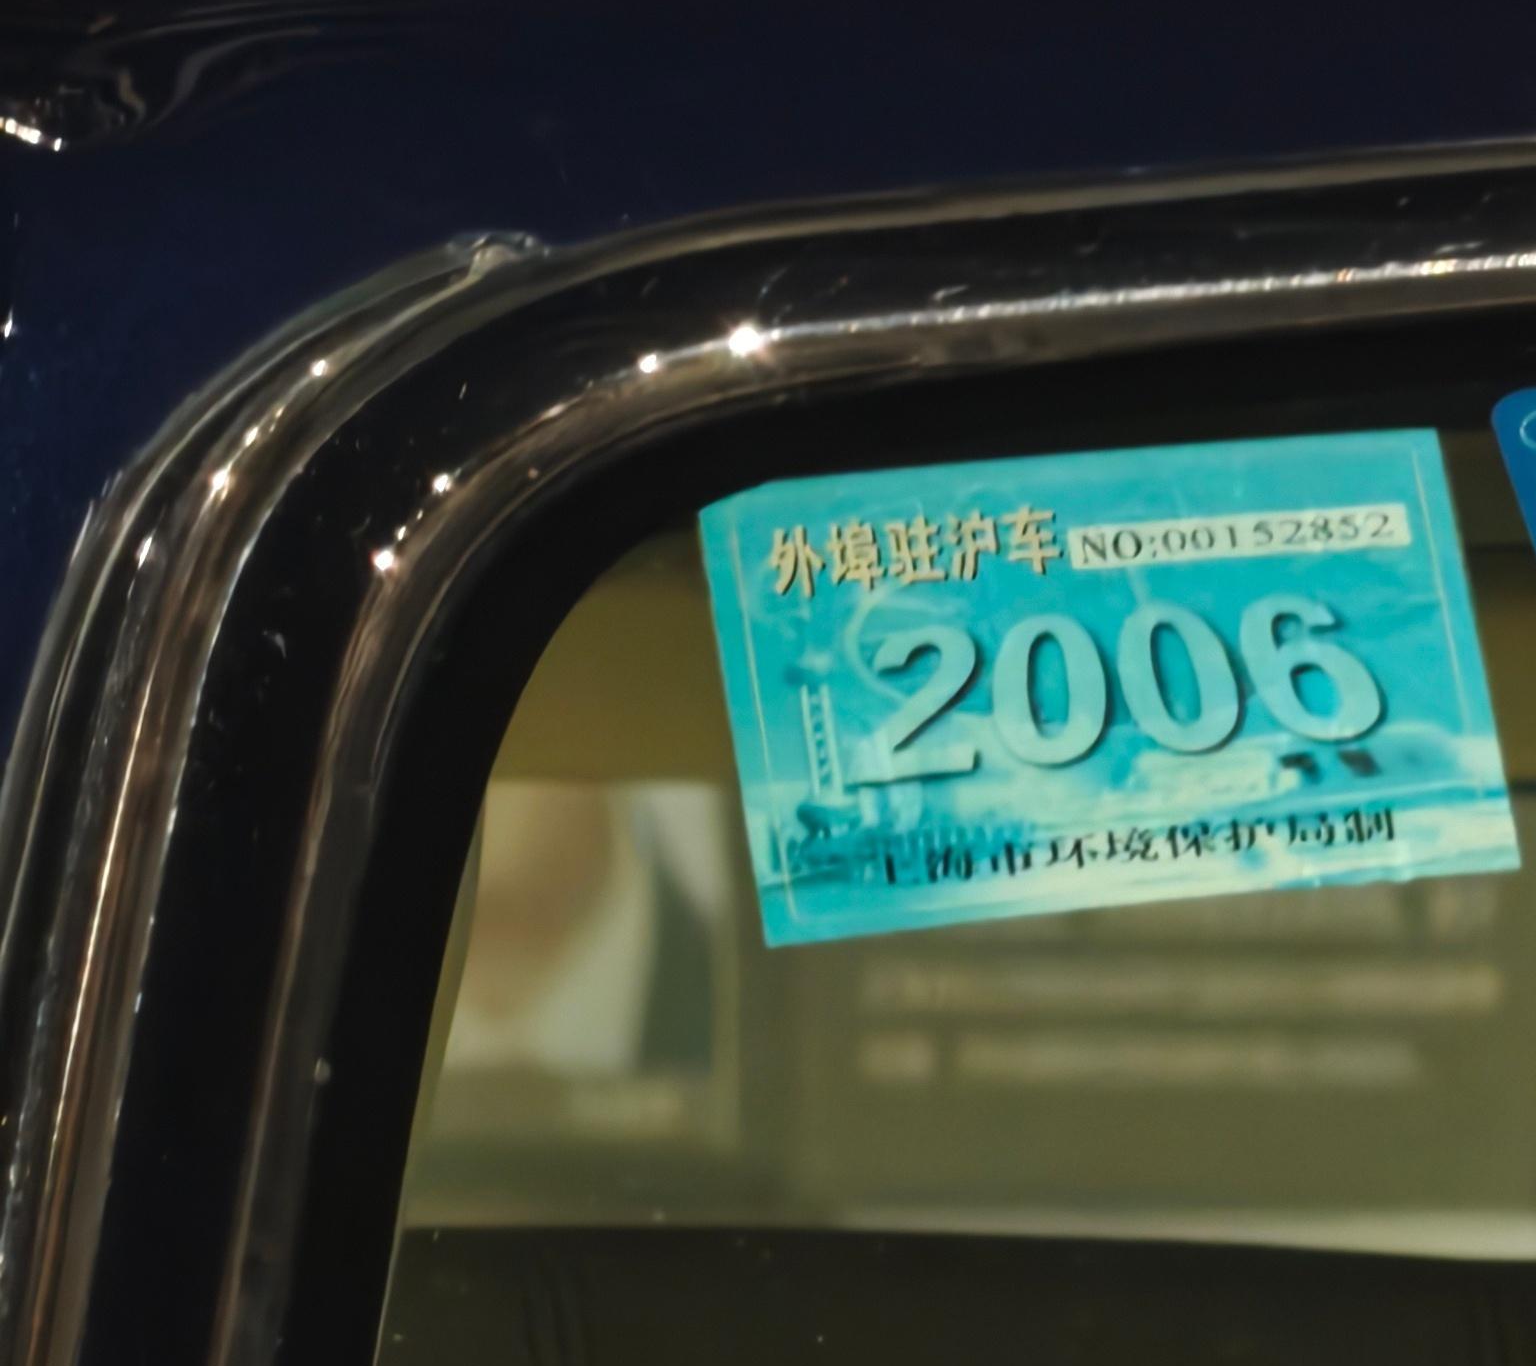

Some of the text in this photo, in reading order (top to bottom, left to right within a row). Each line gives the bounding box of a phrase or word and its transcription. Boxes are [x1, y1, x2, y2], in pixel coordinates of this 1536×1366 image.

[769, 503, 1065, 598] 外埠驻沪车
[1081, 510, 1395, 565] NO:00152852
[845, 593, 1388, 785] 2006
